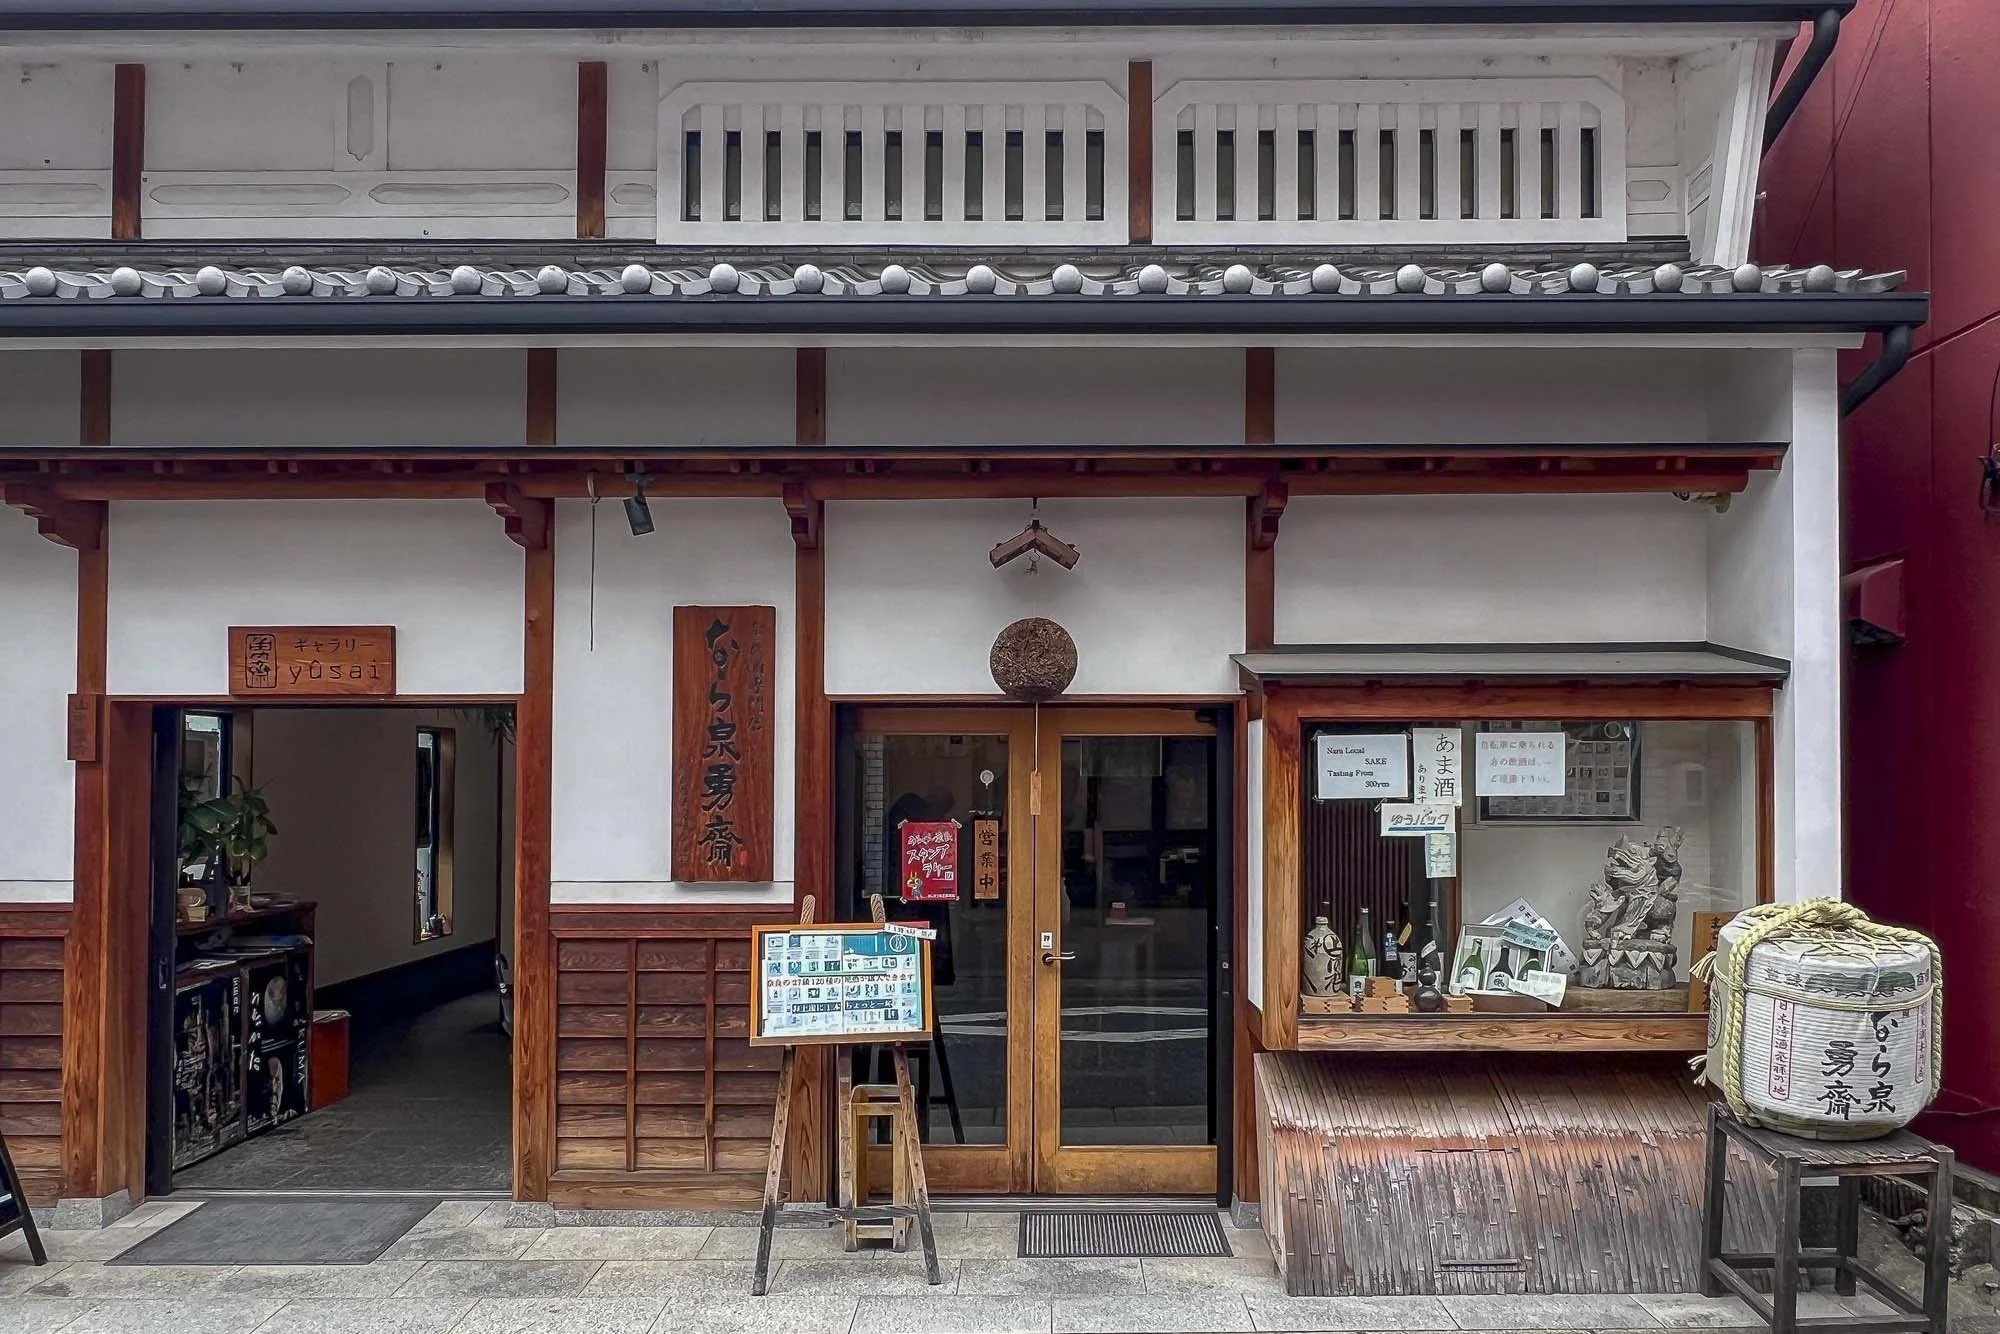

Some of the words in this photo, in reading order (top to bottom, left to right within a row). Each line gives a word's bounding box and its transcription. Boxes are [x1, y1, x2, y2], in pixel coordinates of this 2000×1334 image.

[1327, 747, 1344, 755] Nara
[1345, 747, 1365, 755] Local
[1365, 757, 1388, 765] SAKE
[1434, 734, 1456, 798] あま酒
[1327, 770, 1354, 778] Tasting
[1417, 764, 1428, 804] あります
[1391, 809, 1450, 826] ゆうパック
[907, 843, 949, 865] スタンプ
[978, 830, 997, 891] 営業中
